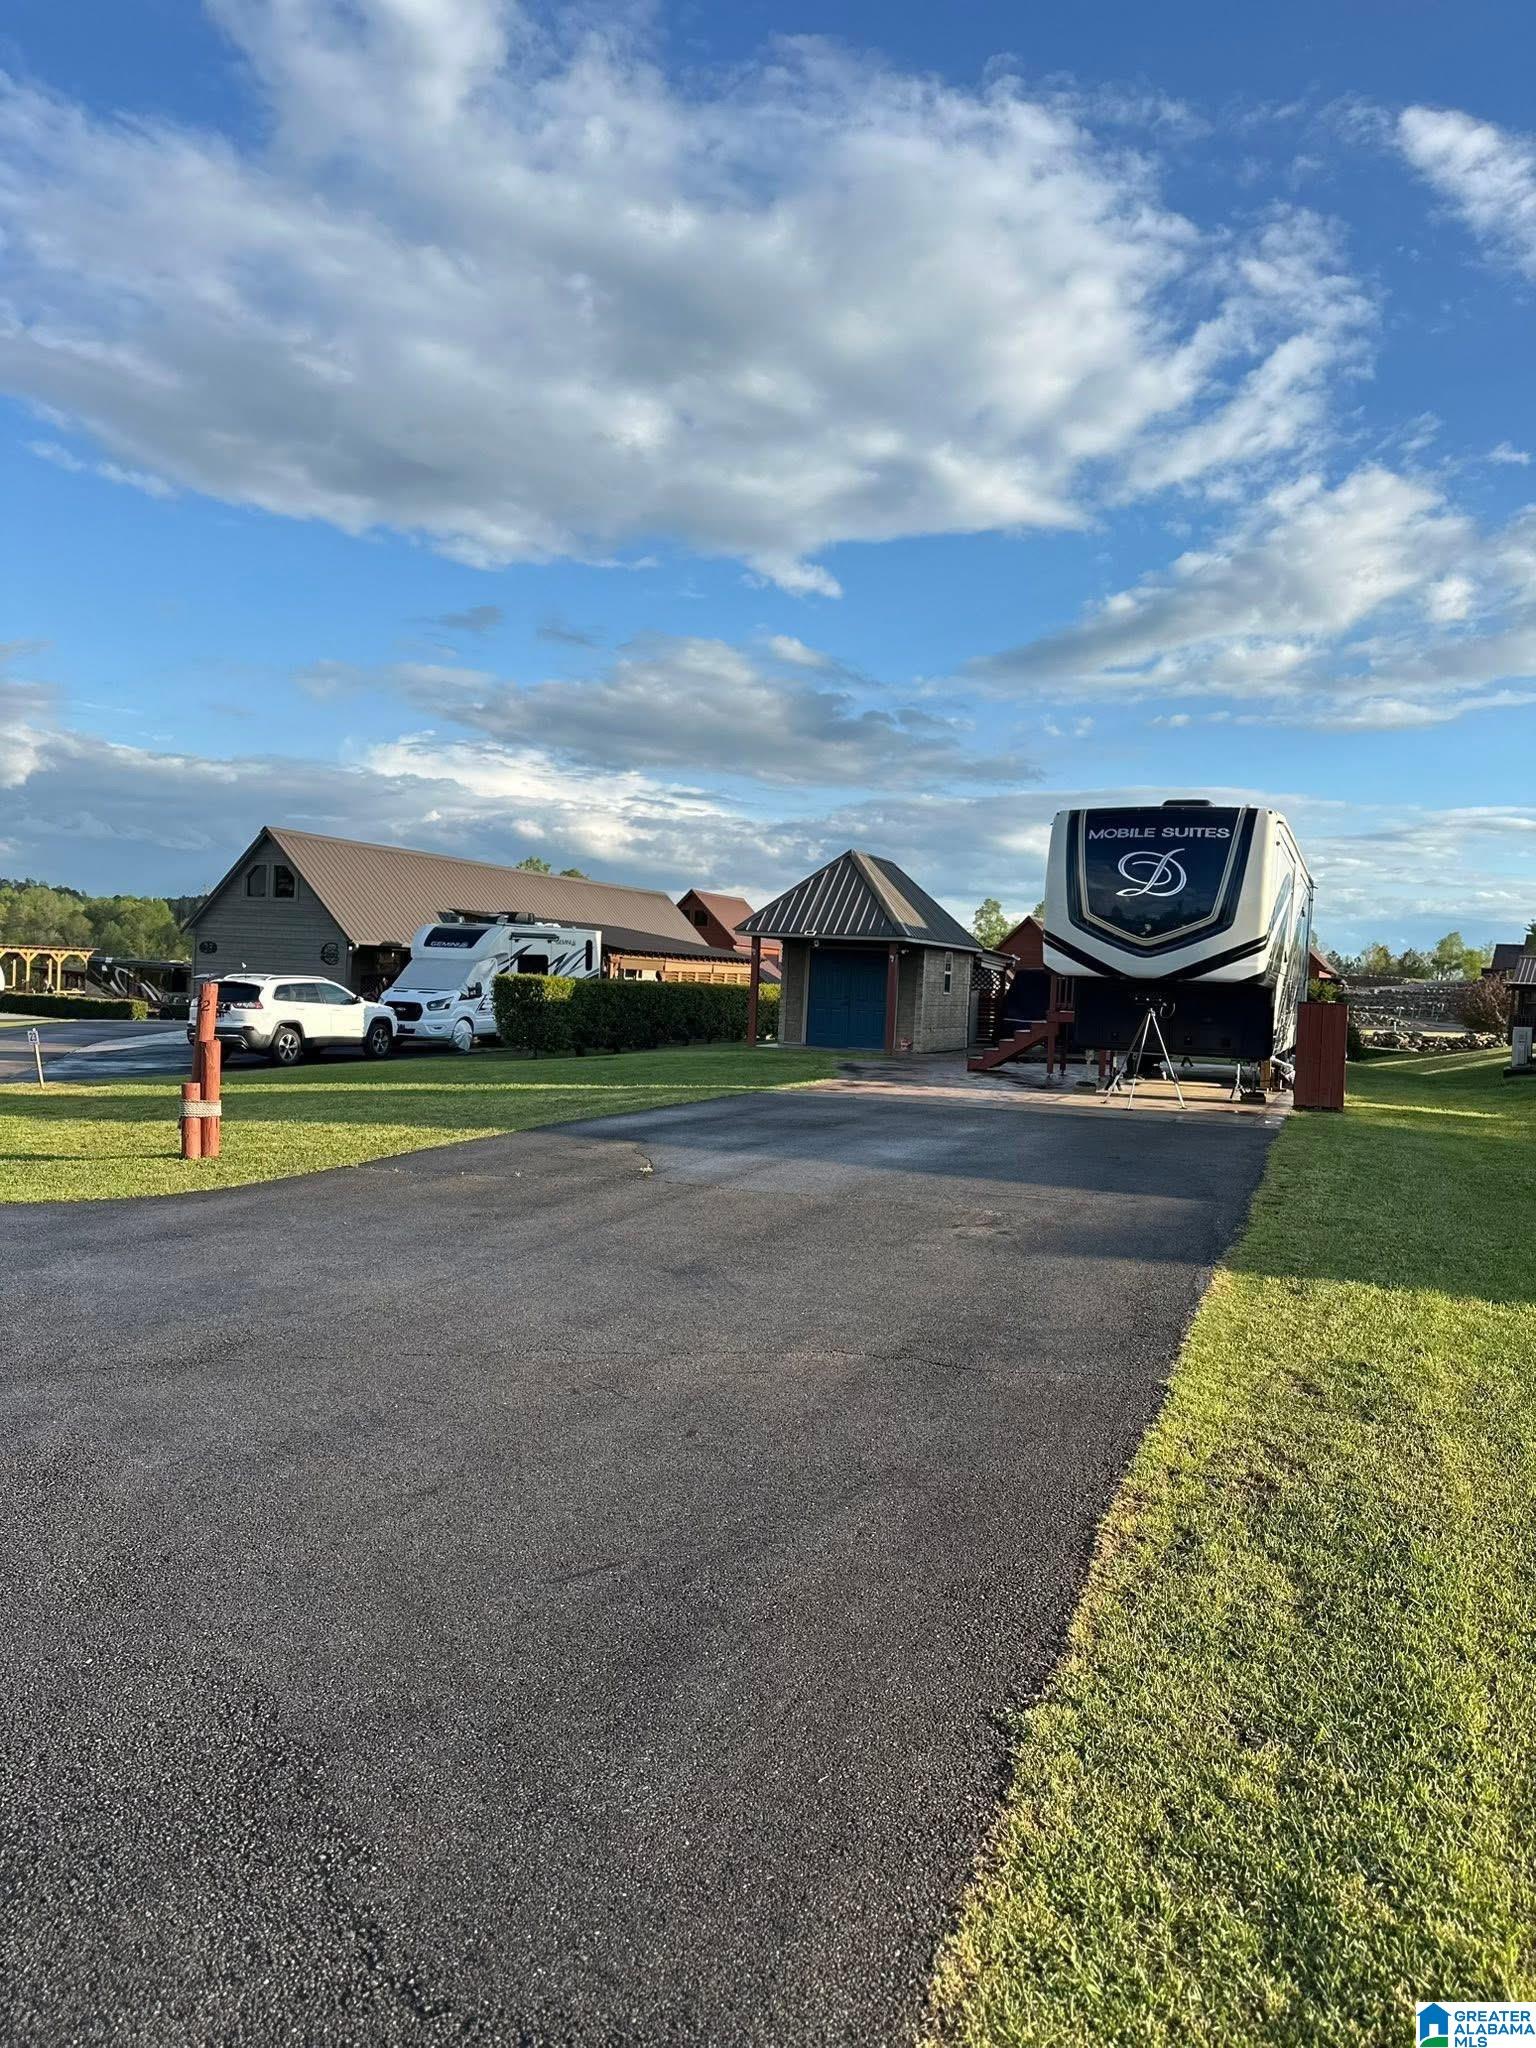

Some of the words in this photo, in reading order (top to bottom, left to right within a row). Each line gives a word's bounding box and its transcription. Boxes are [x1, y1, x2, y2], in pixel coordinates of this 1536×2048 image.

[1088, 828, 1157, 840] MOBILE
[1161, 826, 1231, 839] SUITES
[1115, 848, 1188, 897] D
